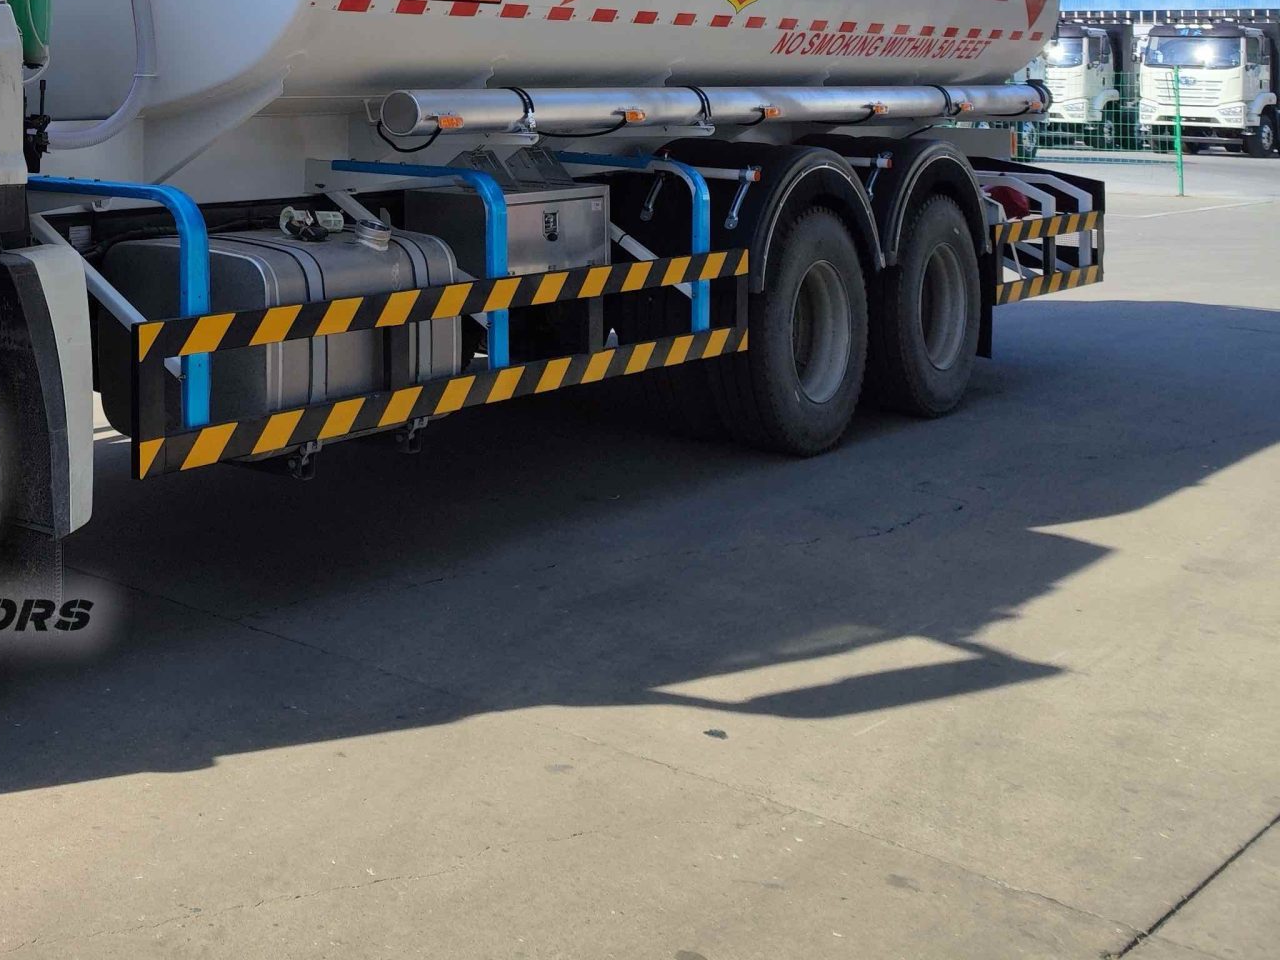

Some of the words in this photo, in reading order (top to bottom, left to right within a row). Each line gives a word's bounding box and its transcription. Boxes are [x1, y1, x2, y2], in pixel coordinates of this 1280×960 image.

[770, 31, 807, 55] NO
[800, 32, 884, 57] SMOKING
[878, 36, 939, 58] WITHIN
[931, 39, 956, 59] 50
[948, 40, 993, 59] FEET
